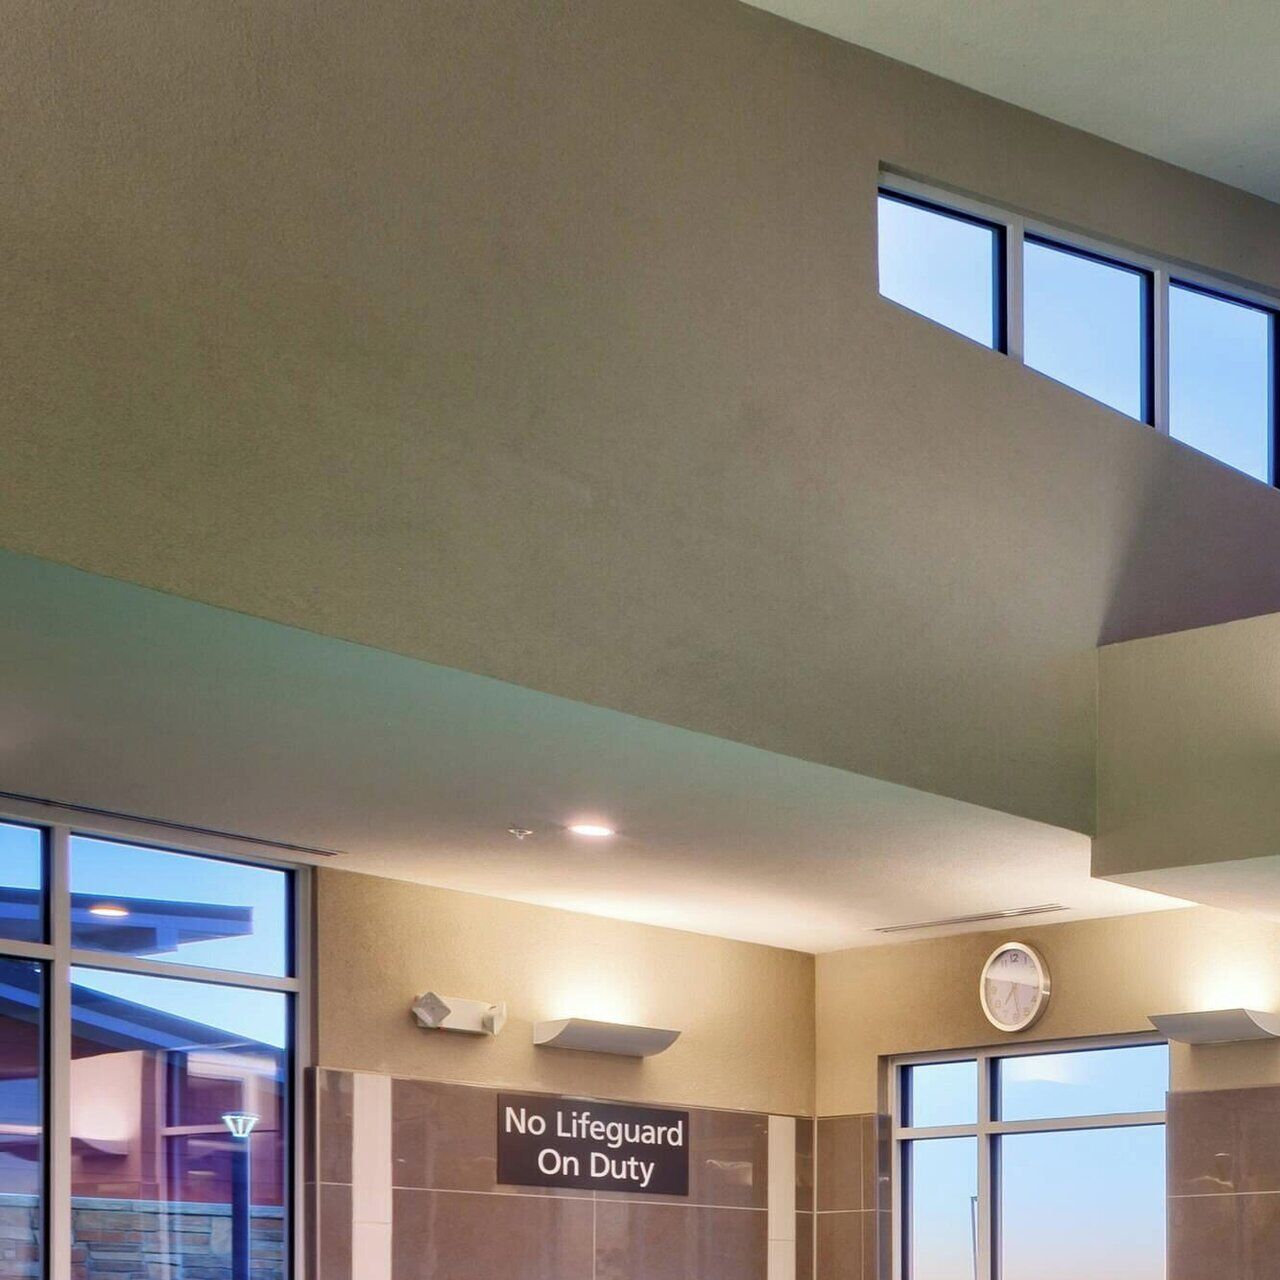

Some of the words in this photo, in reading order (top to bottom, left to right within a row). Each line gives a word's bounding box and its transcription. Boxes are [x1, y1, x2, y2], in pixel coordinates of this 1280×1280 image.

[505, 1106, 546, 1136] No
[556, 1111, 684, 1149] Lifeguard
[537, 1148, 580, 1176] On
[590, 1152, 655, 1188] Duty
